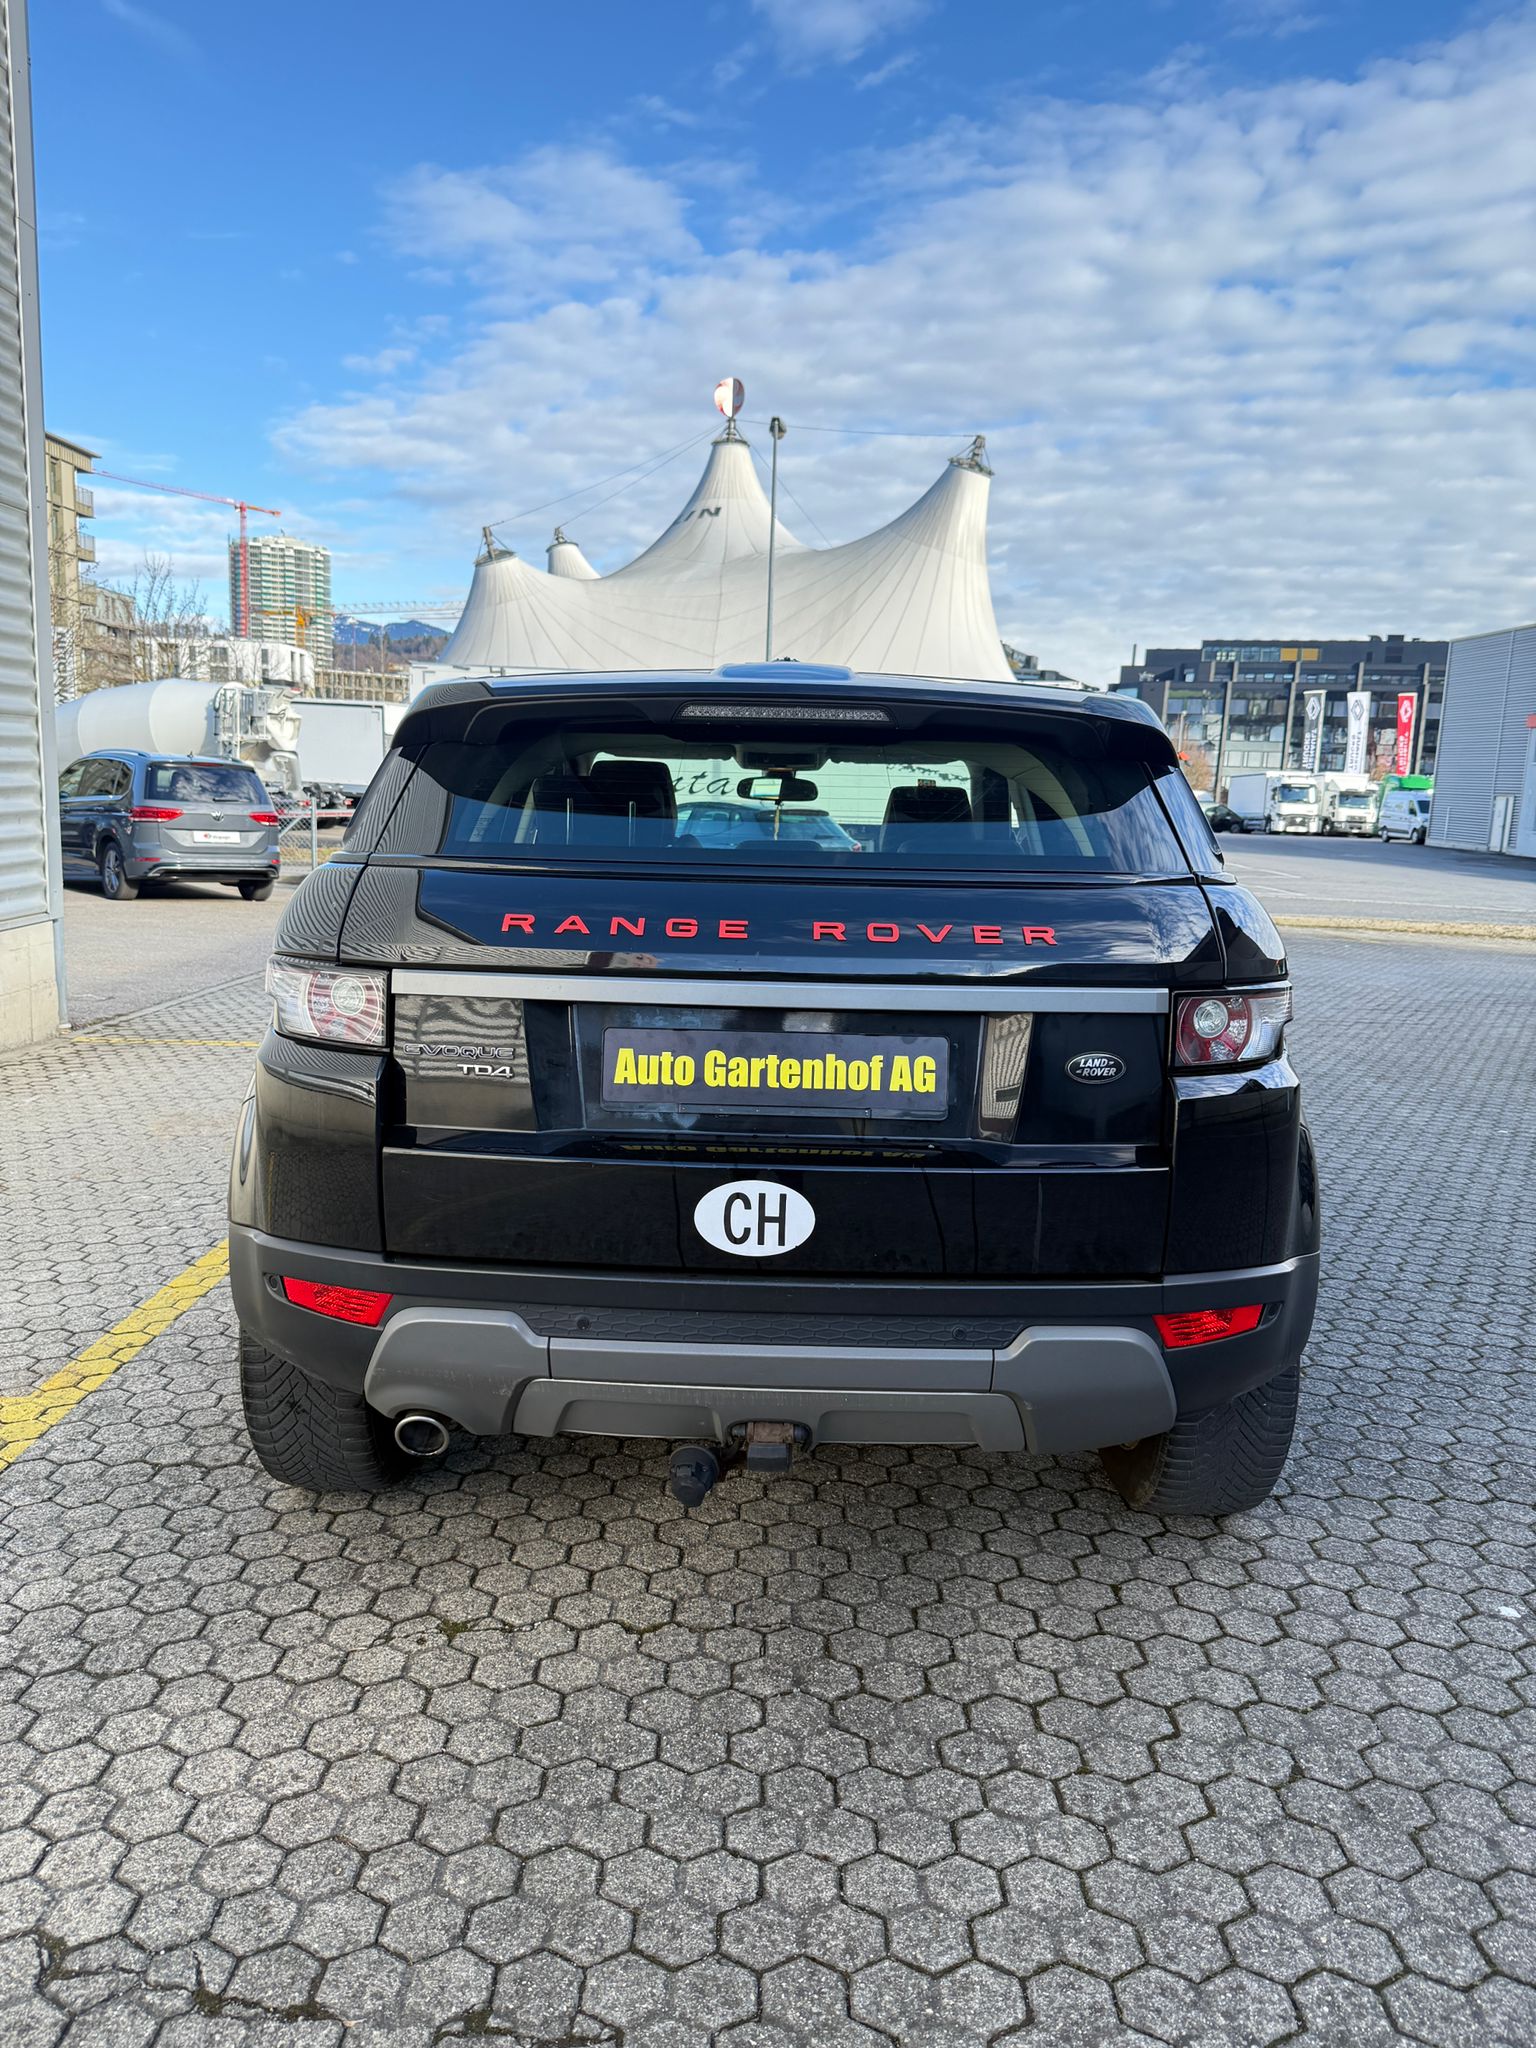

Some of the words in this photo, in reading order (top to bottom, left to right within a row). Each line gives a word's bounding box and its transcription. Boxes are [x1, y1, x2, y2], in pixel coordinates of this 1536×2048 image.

[501, 913, 748, 939] RANGE
[812, 921, 1058, 945] ROVER
[403, 1043, 514, 1059] EVOQUE
[613, 1047, 695, 1086] Auto
[704, 1050, 883, 1091] Gartenhof
[889, 1055, 936, 1093] AG
[1080, 1058, 1107, 1067] LAND
[457, 1064, 514, 1078] TD4
[1082, 1067, 1116, 1076] ROVER
[724, 1192, 787, 1246] CH
